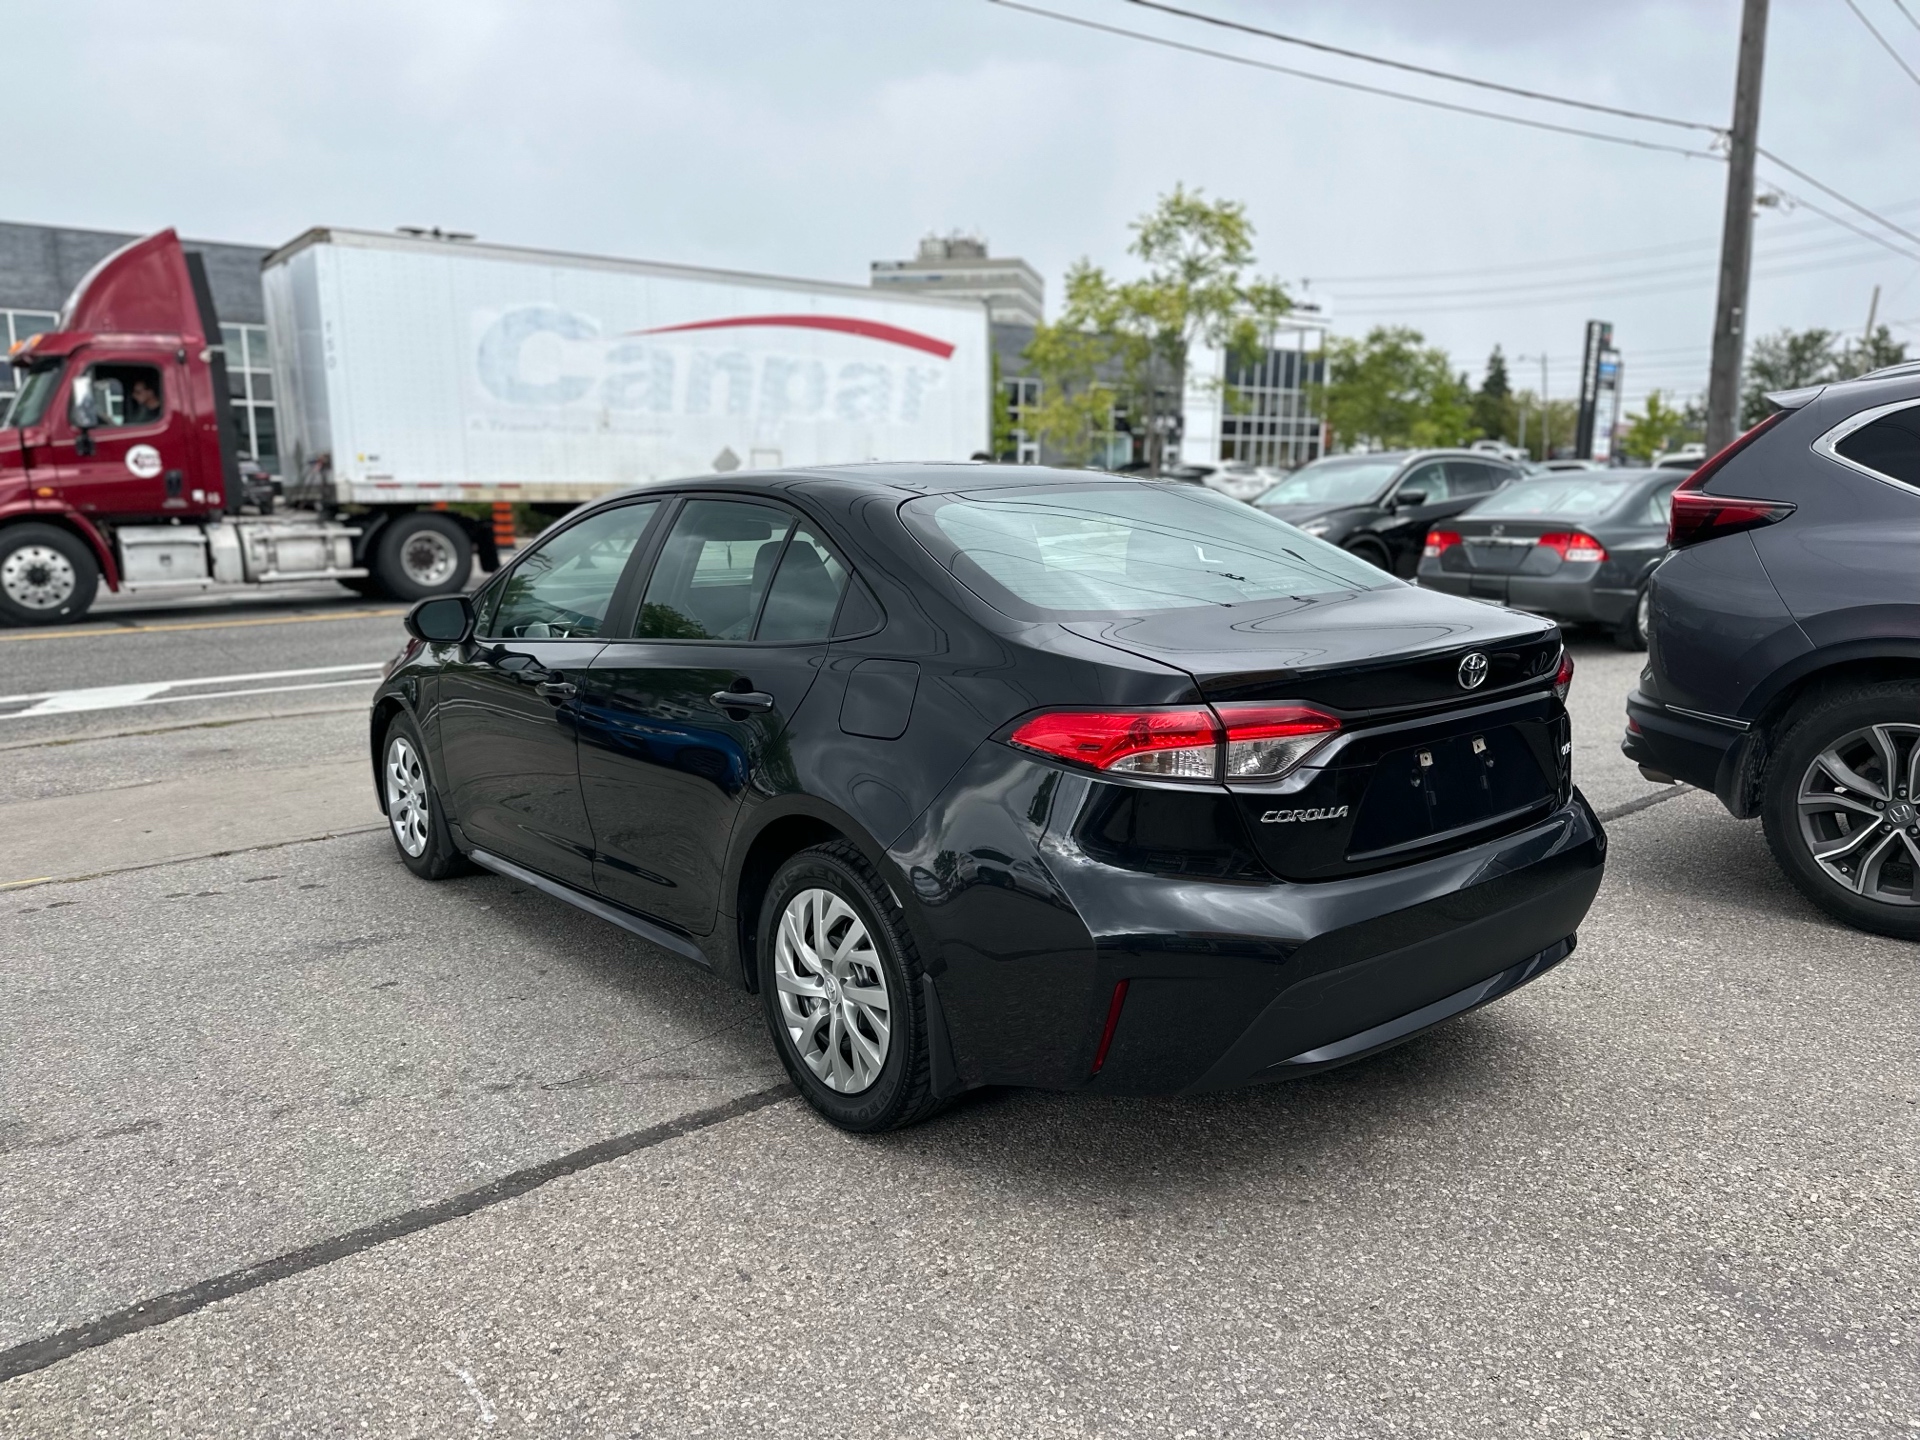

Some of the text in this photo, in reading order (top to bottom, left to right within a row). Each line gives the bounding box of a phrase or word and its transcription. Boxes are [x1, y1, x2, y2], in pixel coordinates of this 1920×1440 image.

[477, 306, 945, 434] Canpar
[1260, 805, 1349, 823] COROLLA
[774, 865, 843, 898] NEXEN
